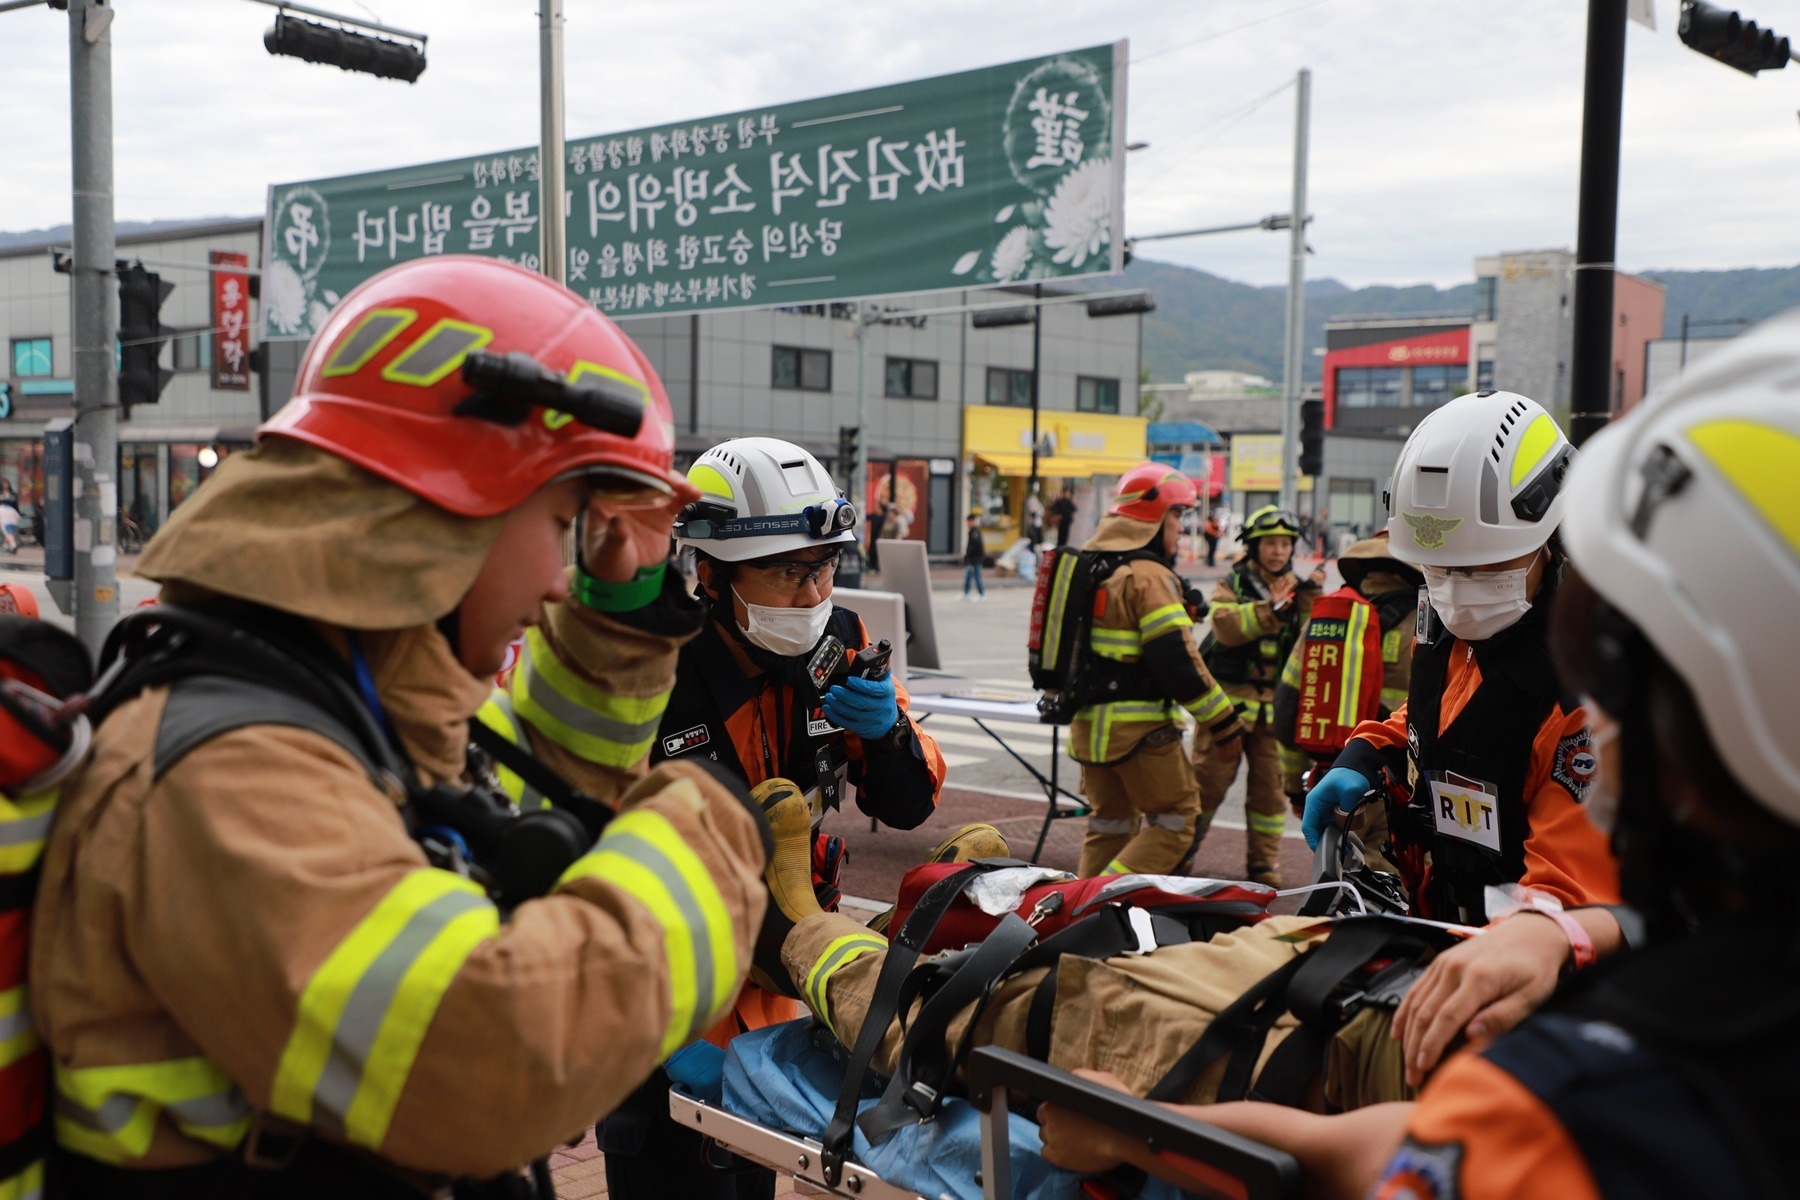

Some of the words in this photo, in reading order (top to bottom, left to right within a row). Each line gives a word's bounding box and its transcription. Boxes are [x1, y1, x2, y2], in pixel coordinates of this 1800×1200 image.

[745, 520, 799, 530] LENSER
[1309, 623, 1346, 637] 포천소방서
[1300, 644, 1321, 739] 신속동료구조팀
[810, 722, 828, 731] FIRE
[1440, 795, 1492, 830] RIT
